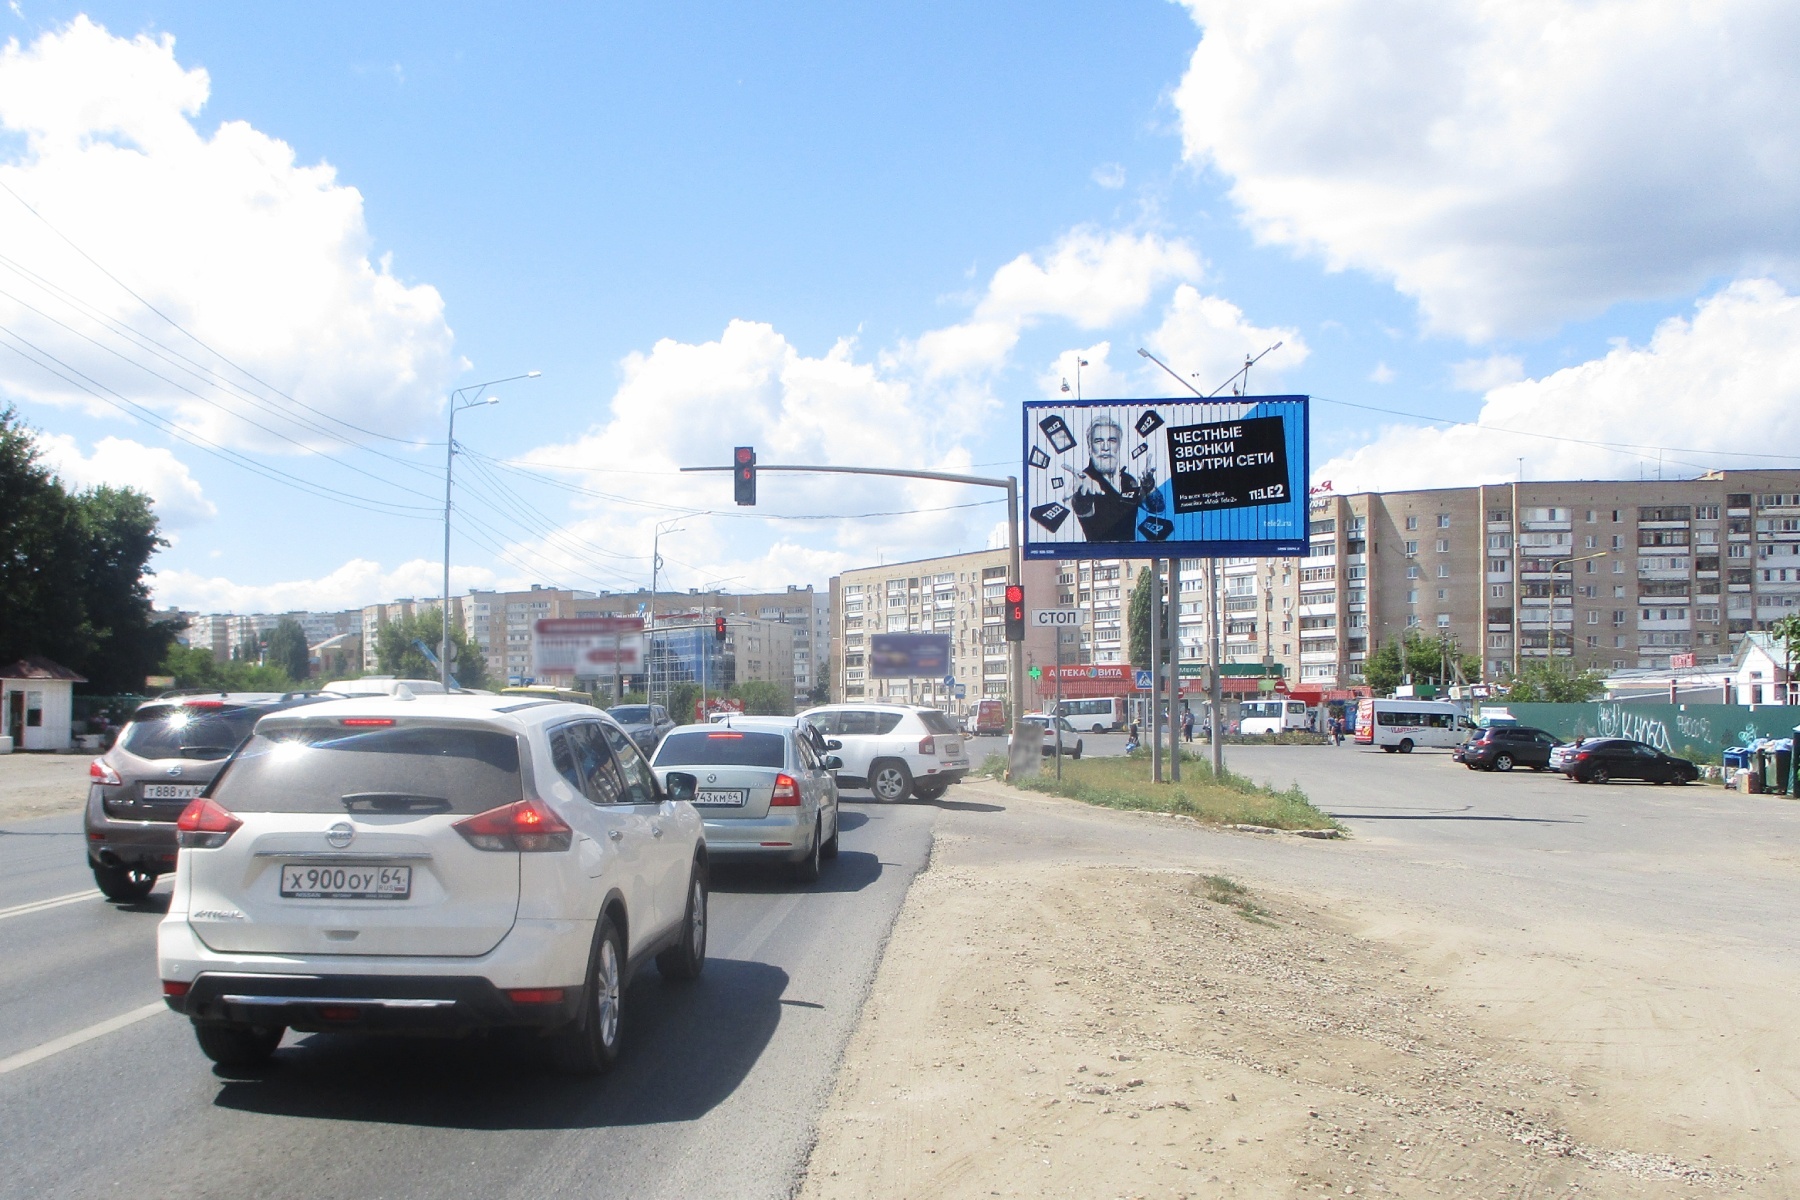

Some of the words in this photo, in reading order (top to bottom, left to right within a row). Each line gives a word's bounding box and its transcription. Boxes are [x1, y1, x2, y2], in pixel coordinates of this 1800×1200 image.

[1173, 426, 1243, 443] ЧЕСТНЫЕ
[1175, 441, 1235, 459] ЗВОНКИ
[1176, 456, 1234, 473] ВНУТРИ
[1236, 452, 1275, 467] СЕТИ
[1249, 483, 1285, 500] TELE2
[1263, 519, 1292, 527] tele2.ru
[1014, 607, 1022, 619] 6
[1039, 611, 1076, 624] СТОП
[1098, 668, 1123, 676] ВИТА
[291, 869, 374, 890] Х900ОУ
[380, 868, 401, 885] 64
